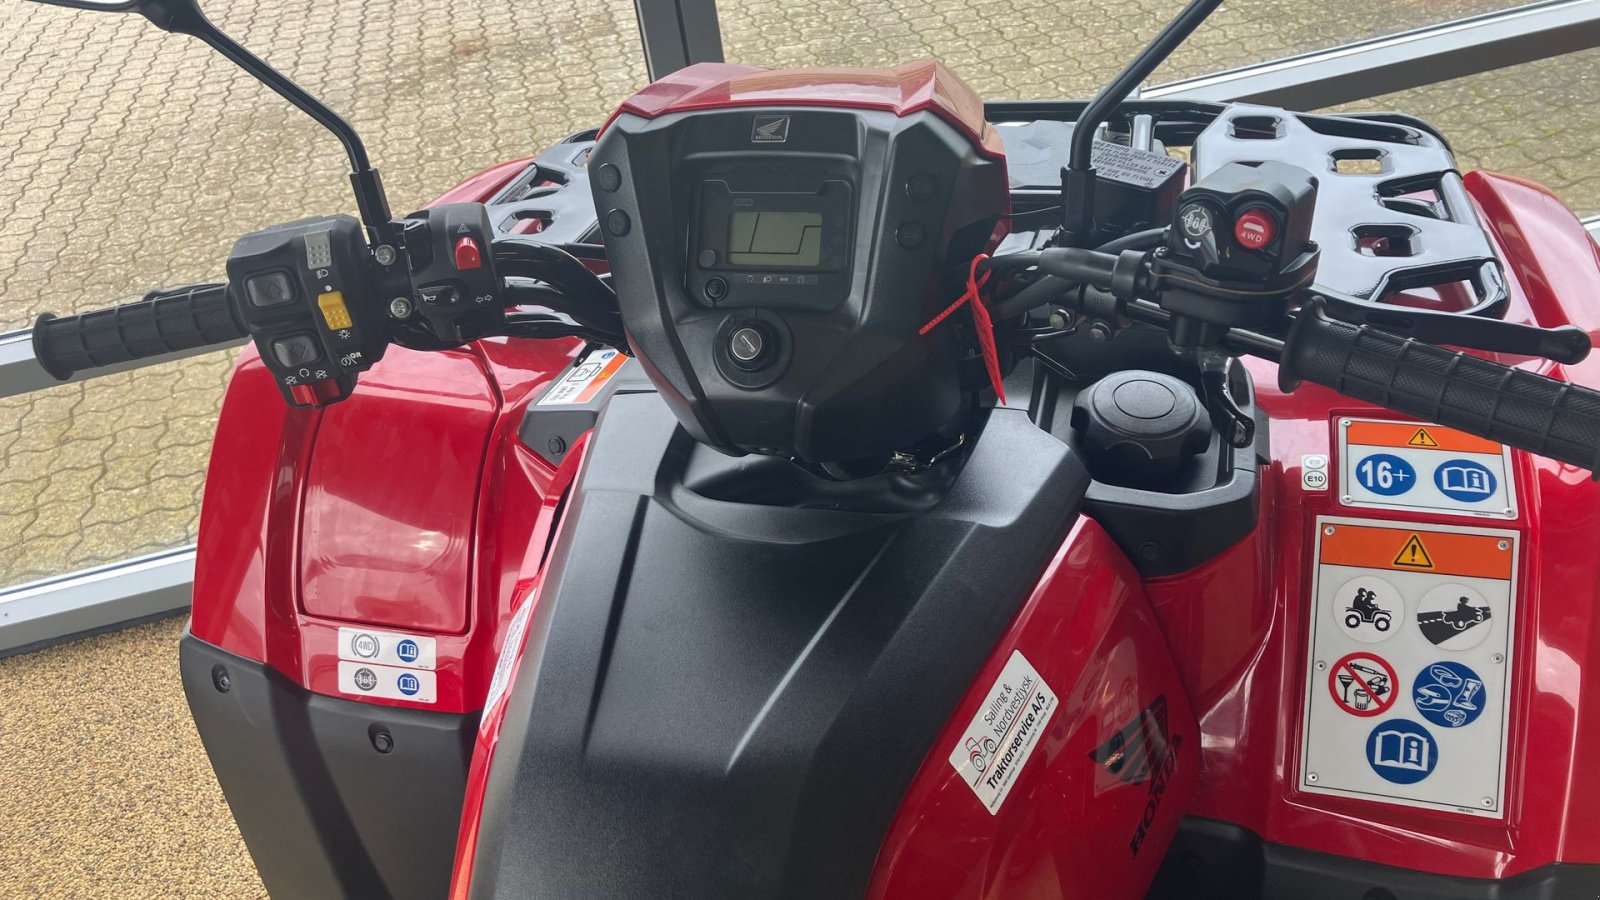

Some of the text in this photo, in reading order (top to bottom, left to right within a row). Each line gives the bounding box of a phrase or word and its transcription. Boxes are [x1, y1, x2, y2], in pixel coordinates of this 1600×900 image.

[1241, 231, 1262, 242] 4WD
[1361, 460, 1410, 489] 16+
[358, 640, 374, 651] 4WD
[983, 683, 1013, 726] Salling &
[993, 675, 1033, 738] Nordvestjysk
[986, 712, 1035, 790] Traktorservice
[1031, 691, 1046, 716] A/S
[1130, 734, 1184, 860] HONDA
